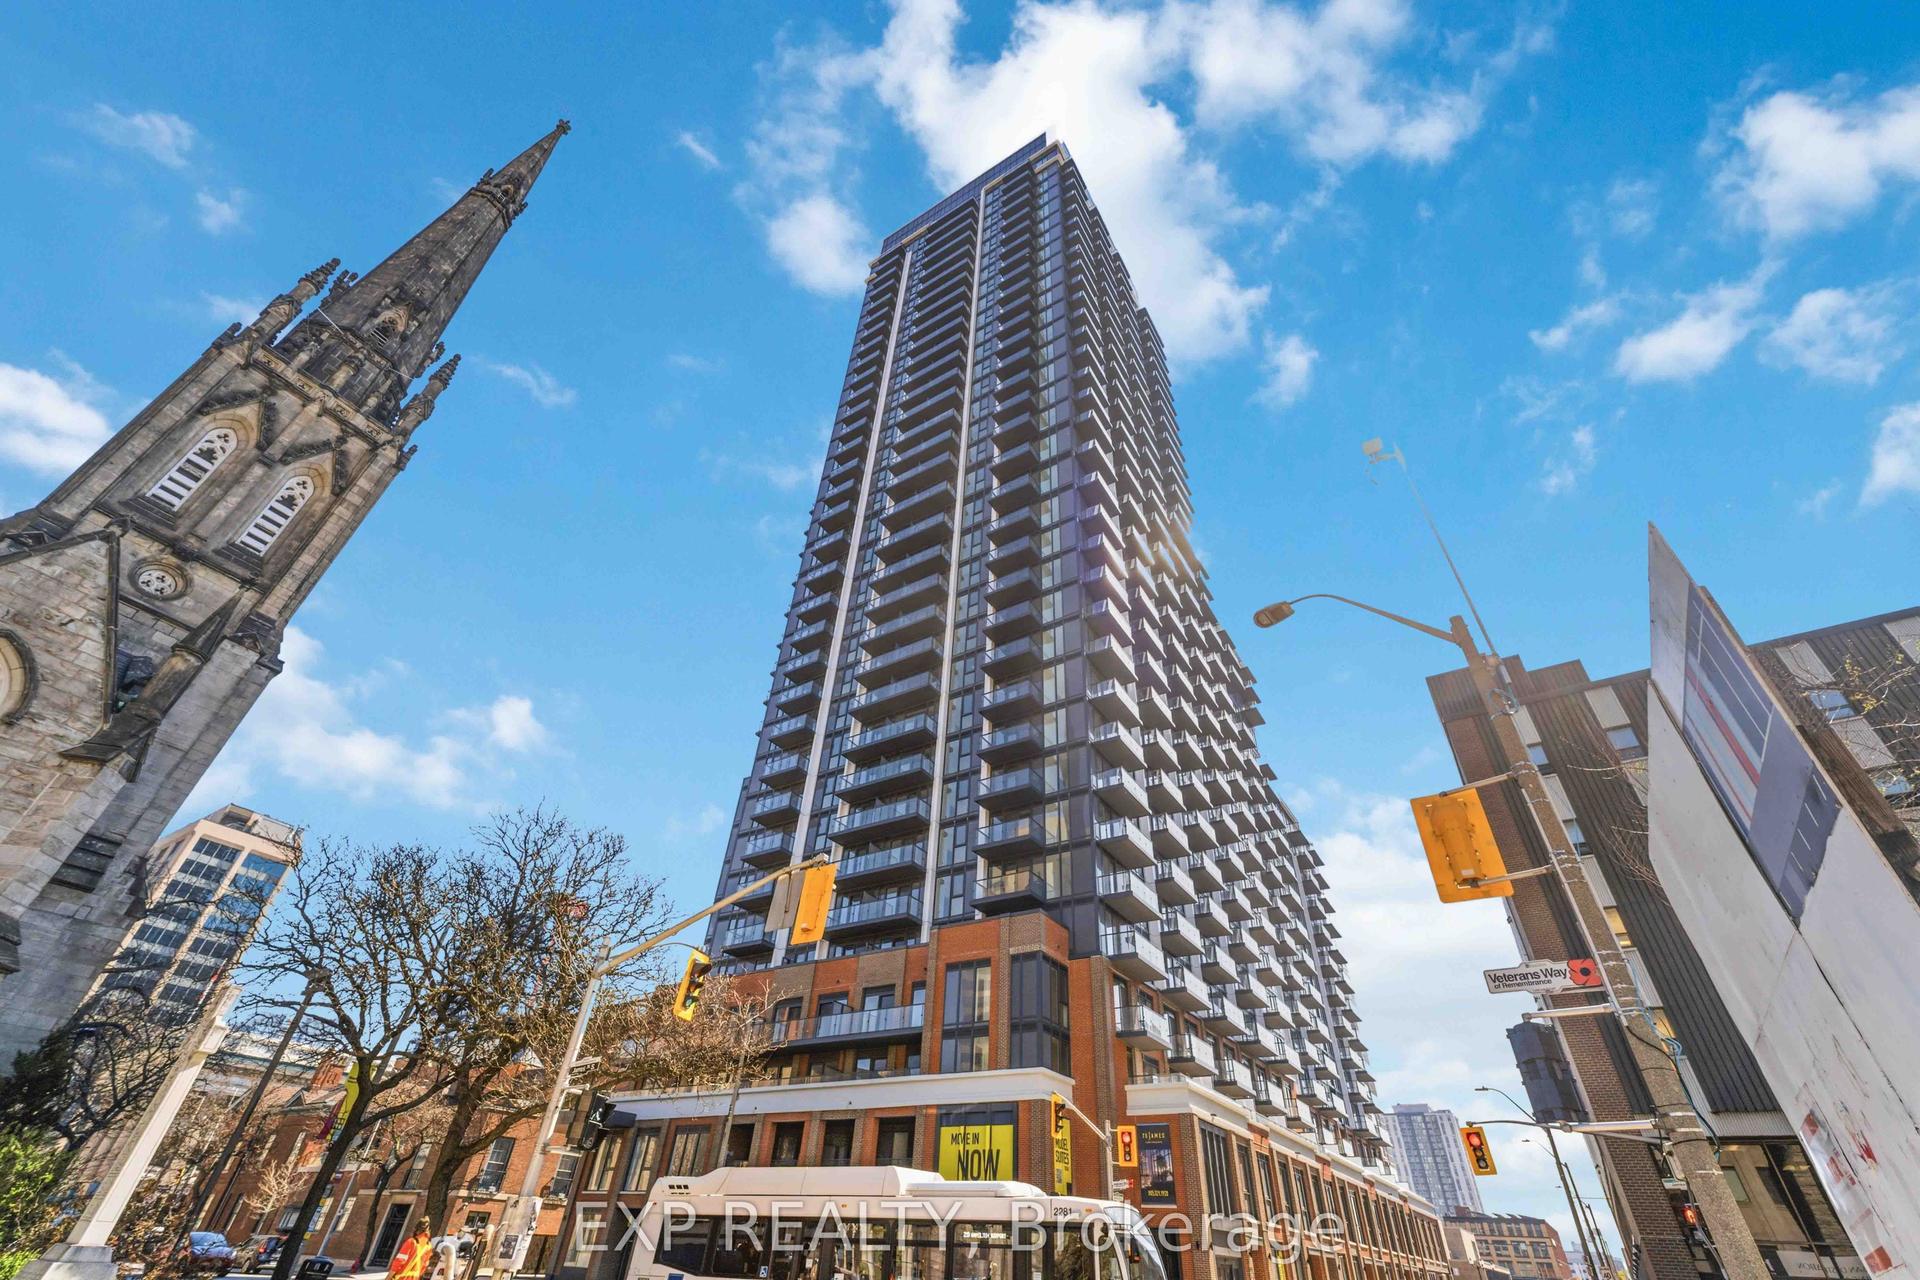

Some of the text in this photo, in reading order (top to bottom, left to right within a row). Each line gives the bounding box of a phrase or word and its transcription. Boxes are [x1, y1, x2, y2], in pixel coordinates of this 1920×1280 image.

[1488, 968, 1567, 983] Veterans Way
[1494, 979, 1552, 990] of Remembrance
[951, 1132, 980, 1145] MOVE IN
[957, 1148, 1001, 1181] NOW
[1053, 1207, 1073, 1217] 2281
